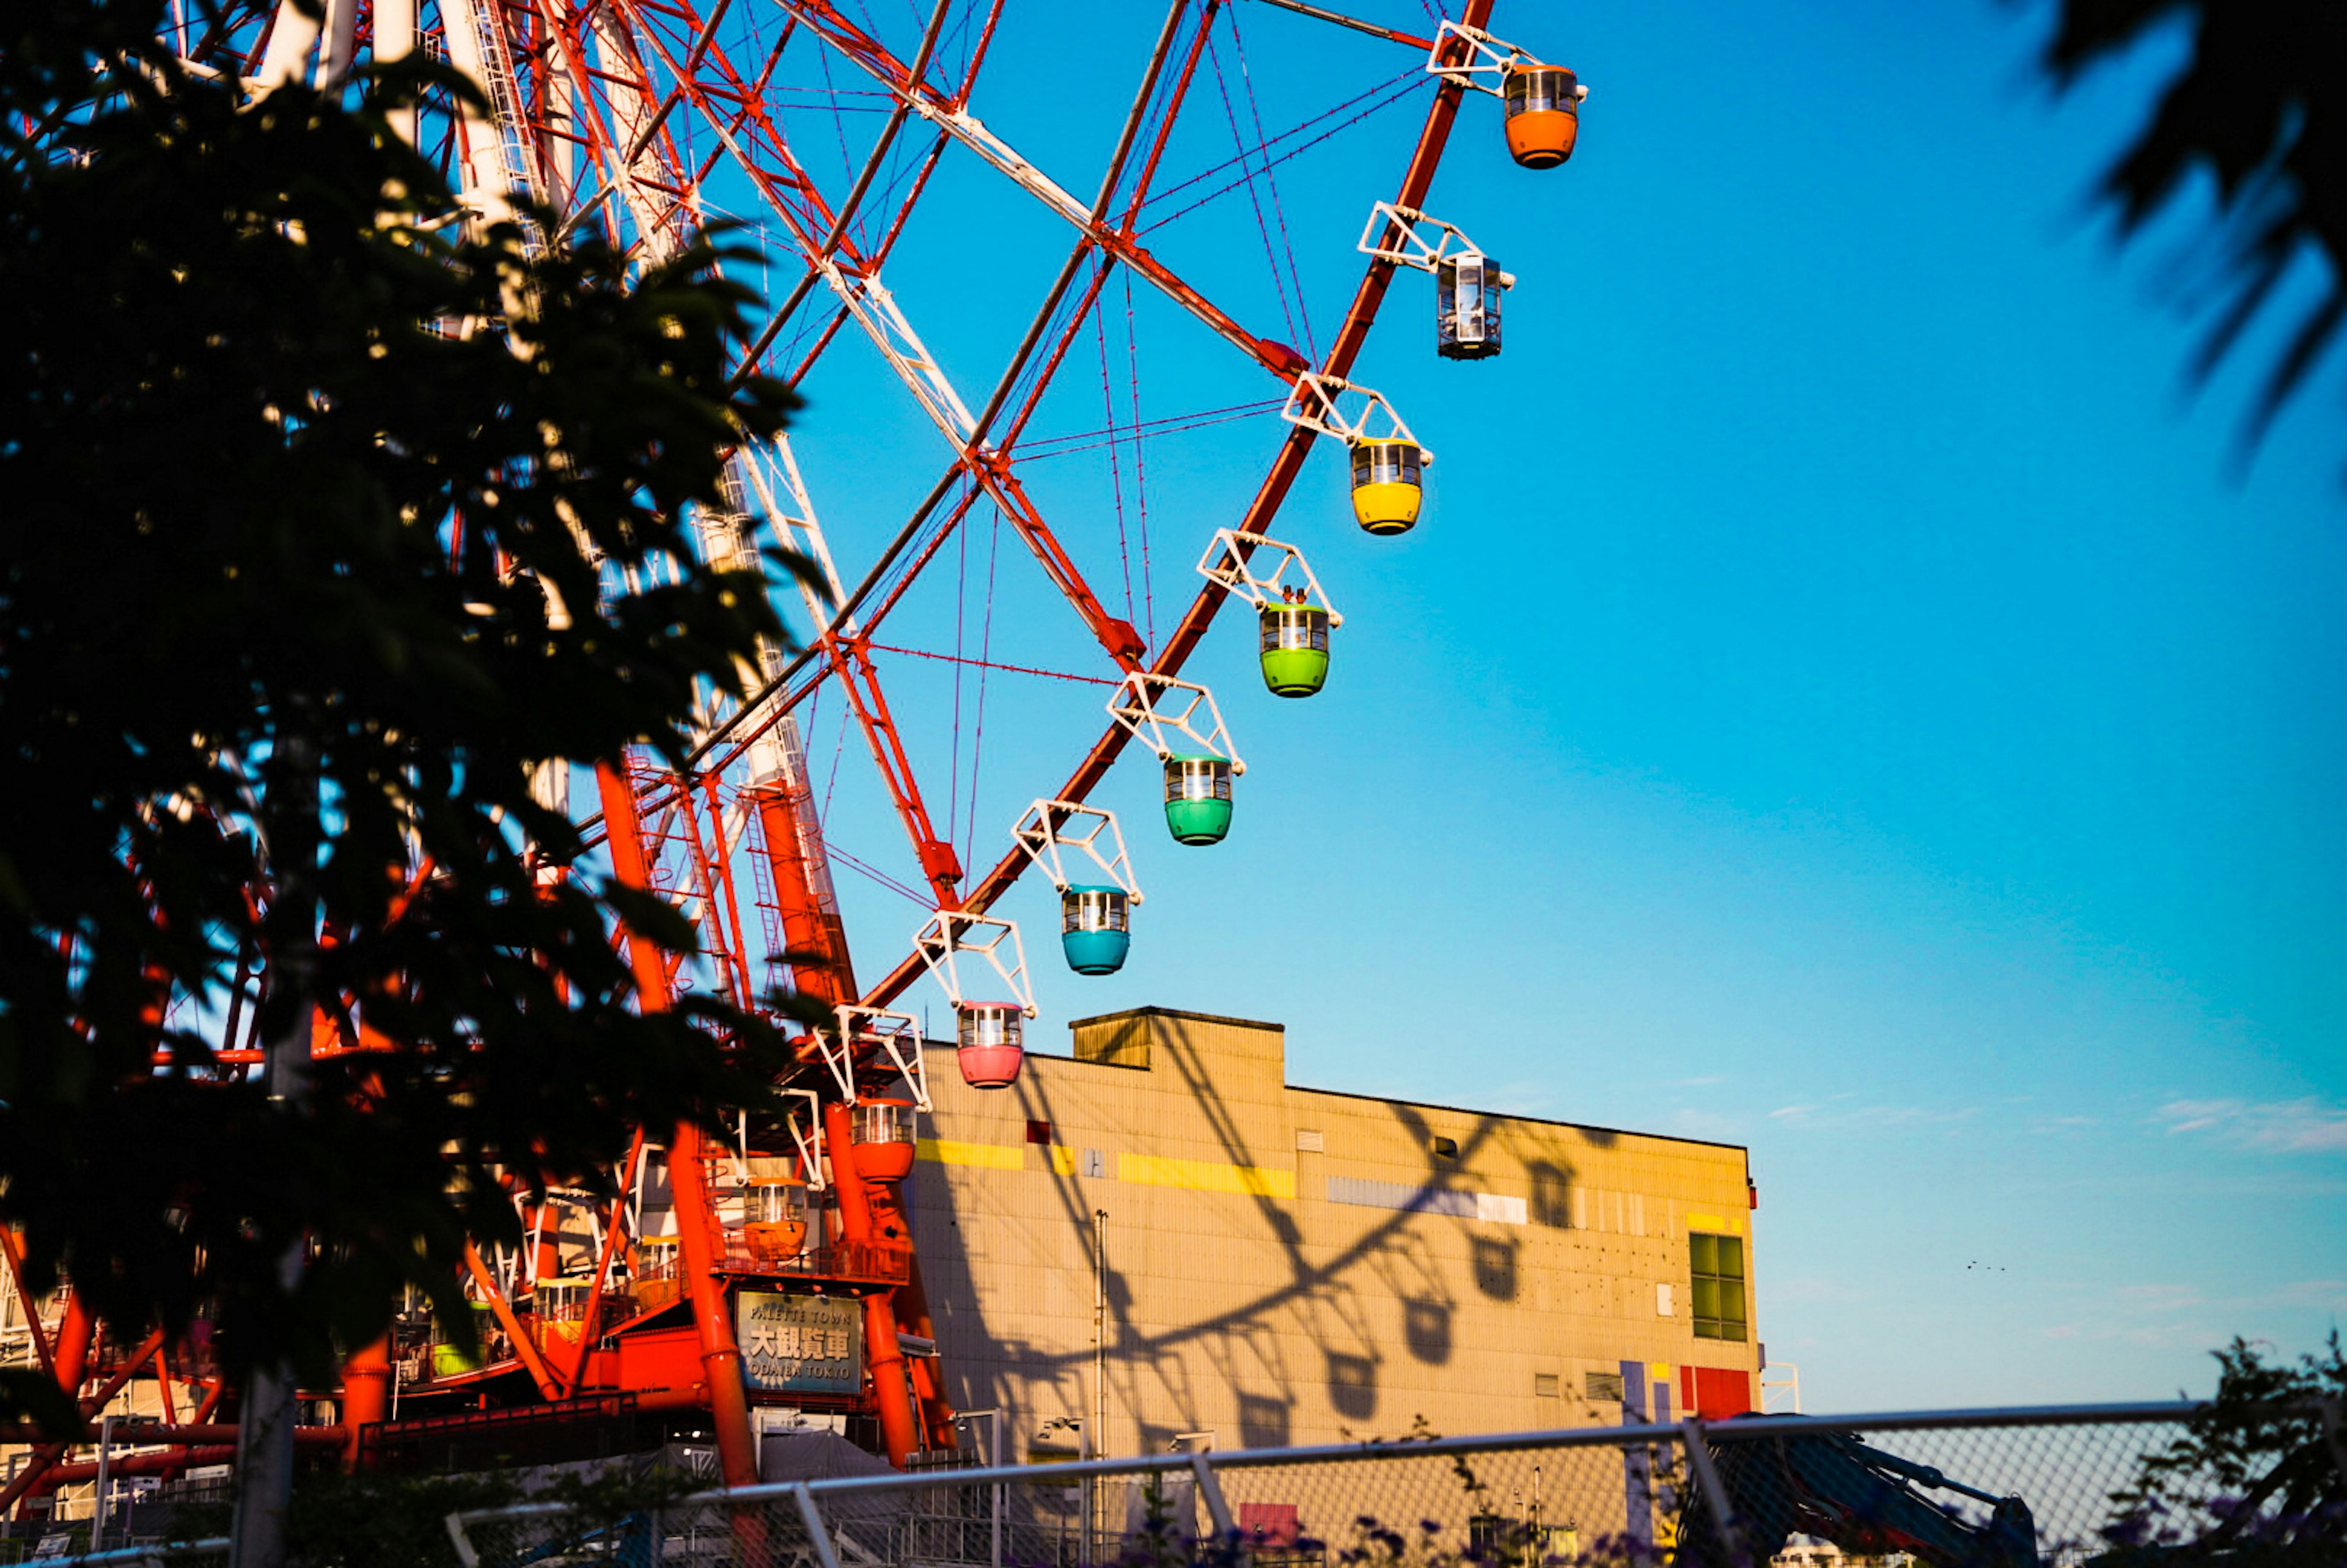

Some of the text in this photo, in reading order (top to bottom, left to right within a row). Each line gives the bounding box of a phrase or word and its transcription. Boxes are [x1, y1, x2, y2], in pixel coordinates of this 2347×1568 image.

[751, 1307, 851, 1325] PALETTE TOWN
[750, 1325, 850, 1361] 大観覧車
[751, 1363, 850, 1379] ODAIBA TOKYO
